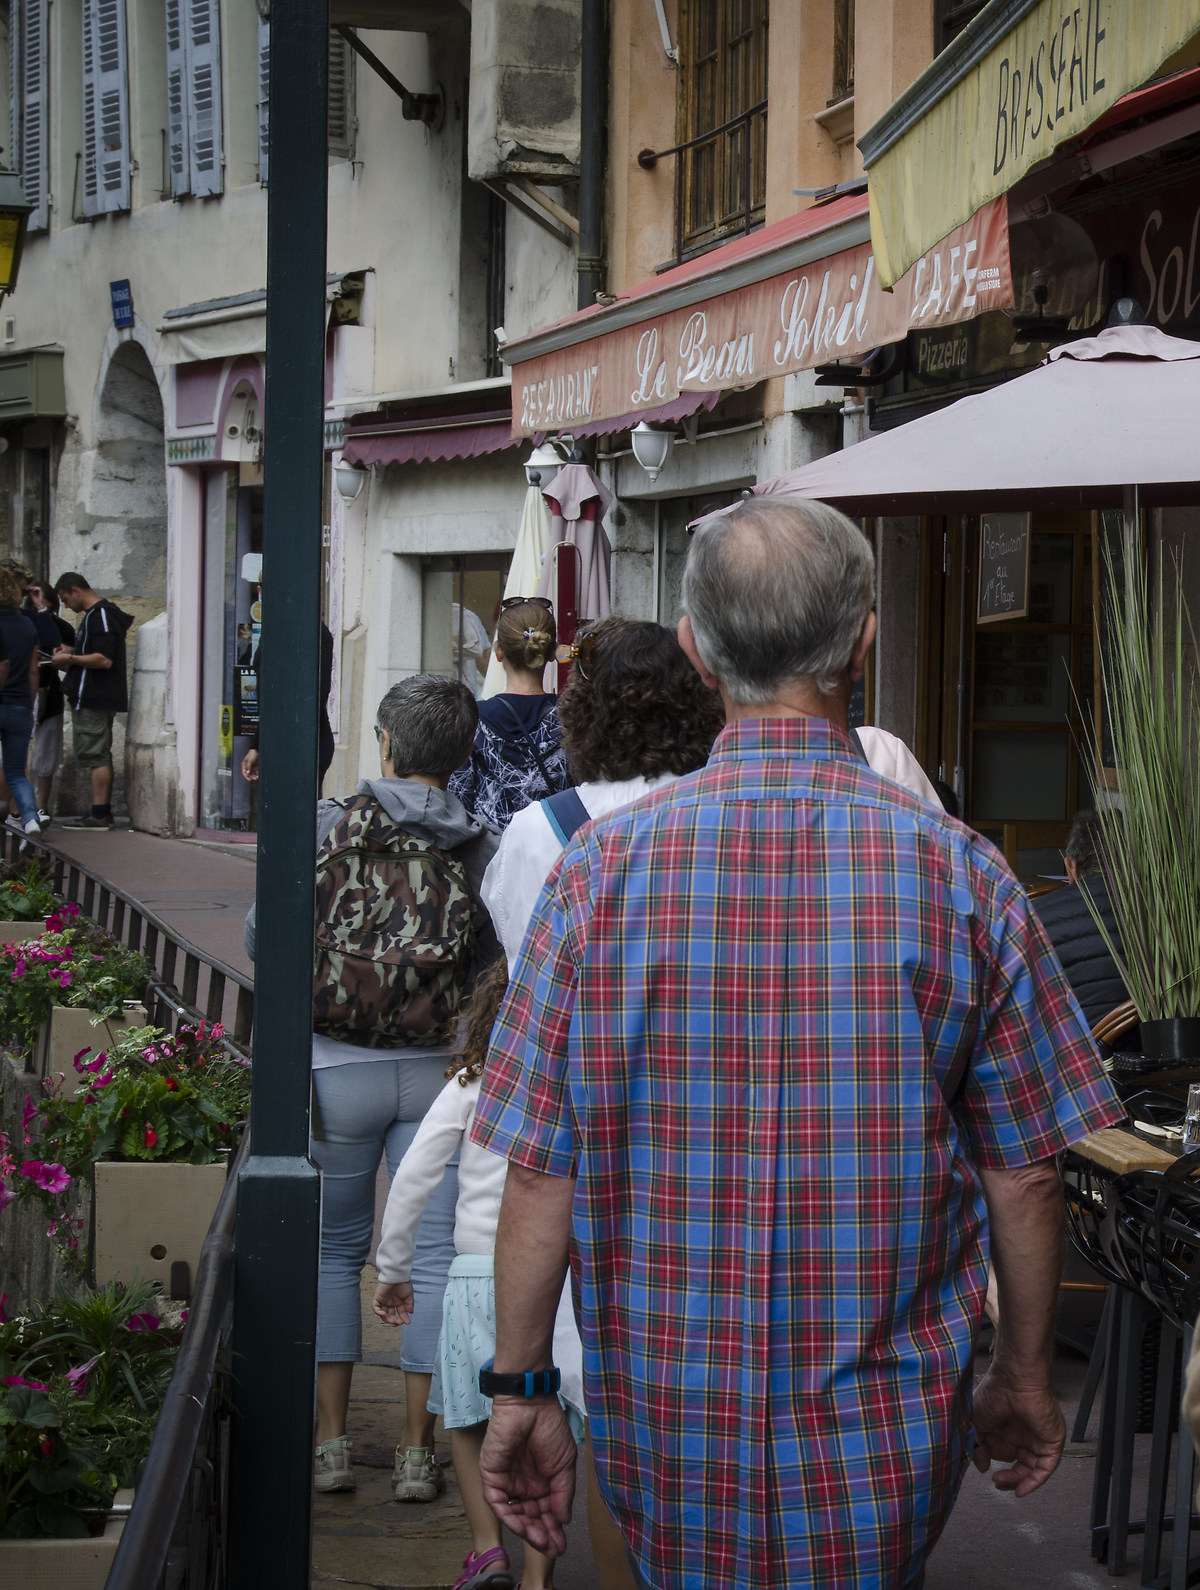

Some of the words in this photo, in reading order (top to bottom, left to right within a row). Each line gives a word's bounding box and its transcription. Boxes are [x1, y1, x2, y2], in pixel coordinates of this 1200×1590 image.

[521, 365, 598, 428] RESAURANT
[631, 327, 668, 404] Le
[676, 311, 755, 385] Beau
[774, 255, 875, 365] Soleil
[918, 329, 968, 374] Pizzeria
[983, 521, 1027, 560] Restaurant
[996, 566, 1008, 578] au
